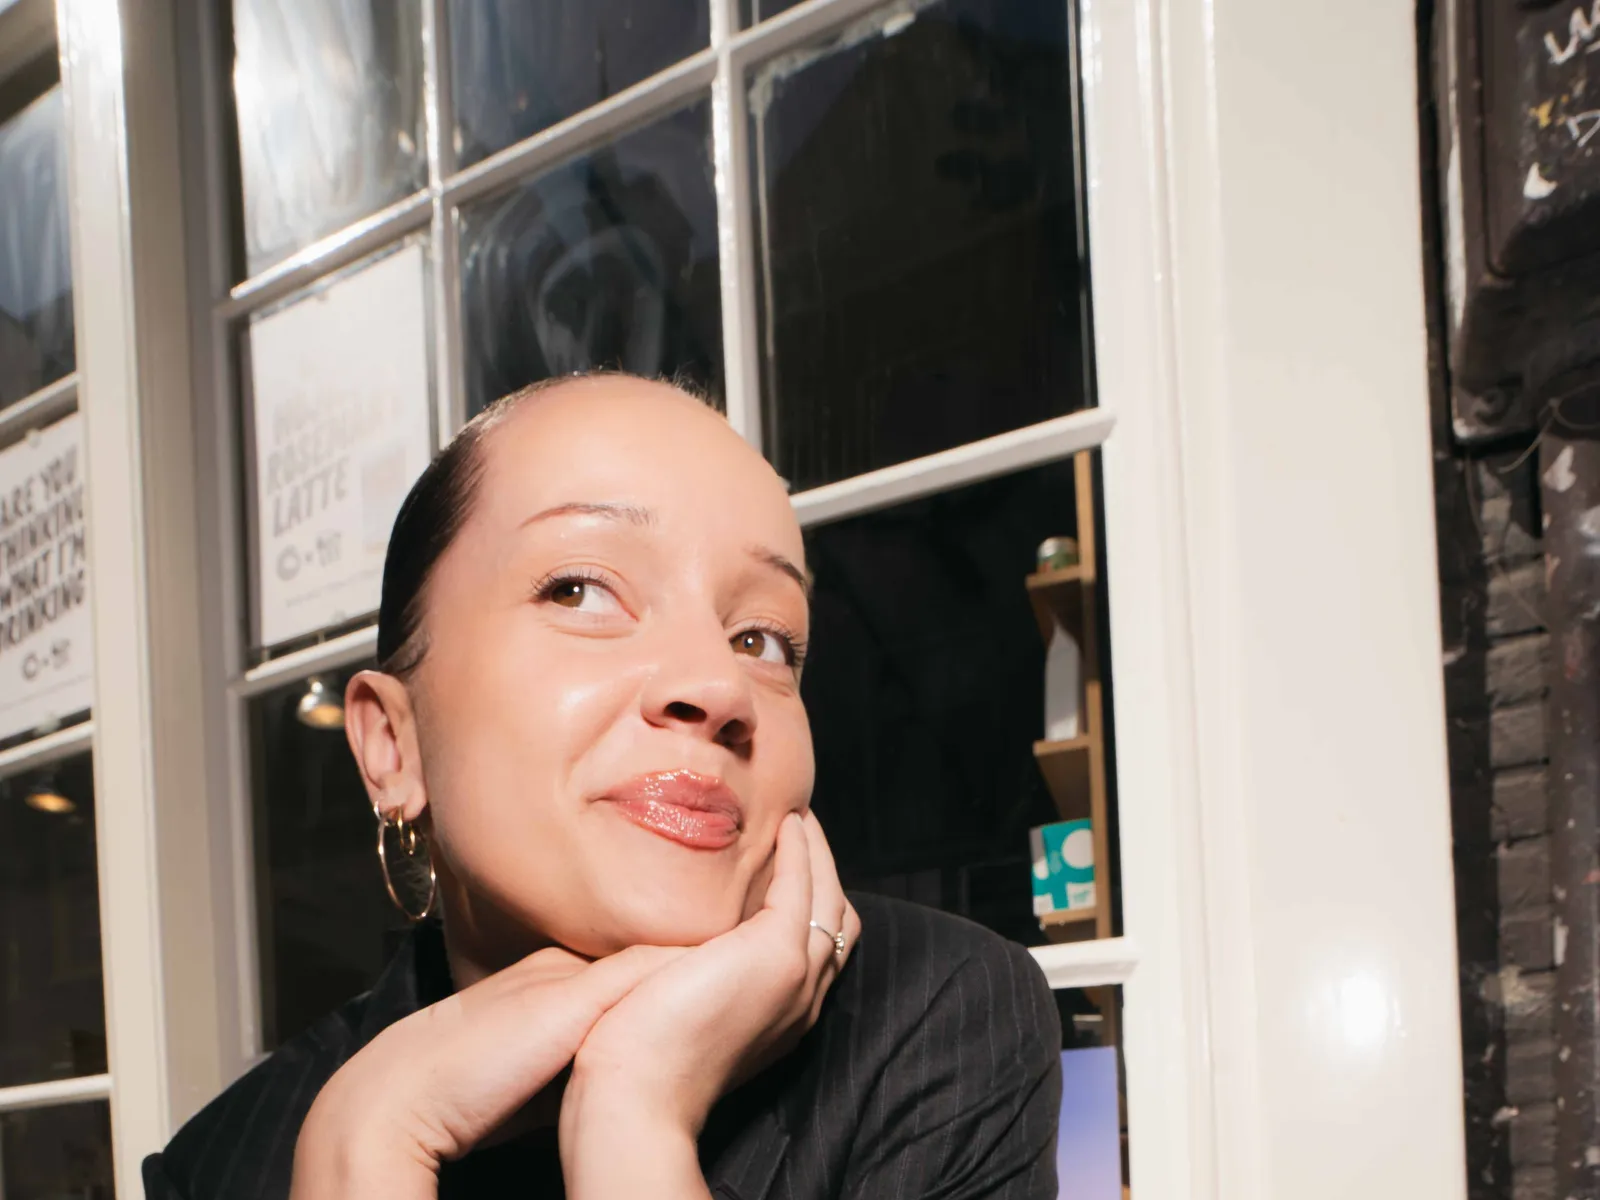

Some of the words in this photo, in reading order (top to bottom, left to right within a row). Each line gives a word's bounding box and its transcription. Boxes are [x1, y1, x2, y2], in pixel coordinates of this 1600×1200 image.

[0, 473, 33, 526] ARE
[39, 443, 77, 499] YOU
[273, 455, 350, 538] LATTE
